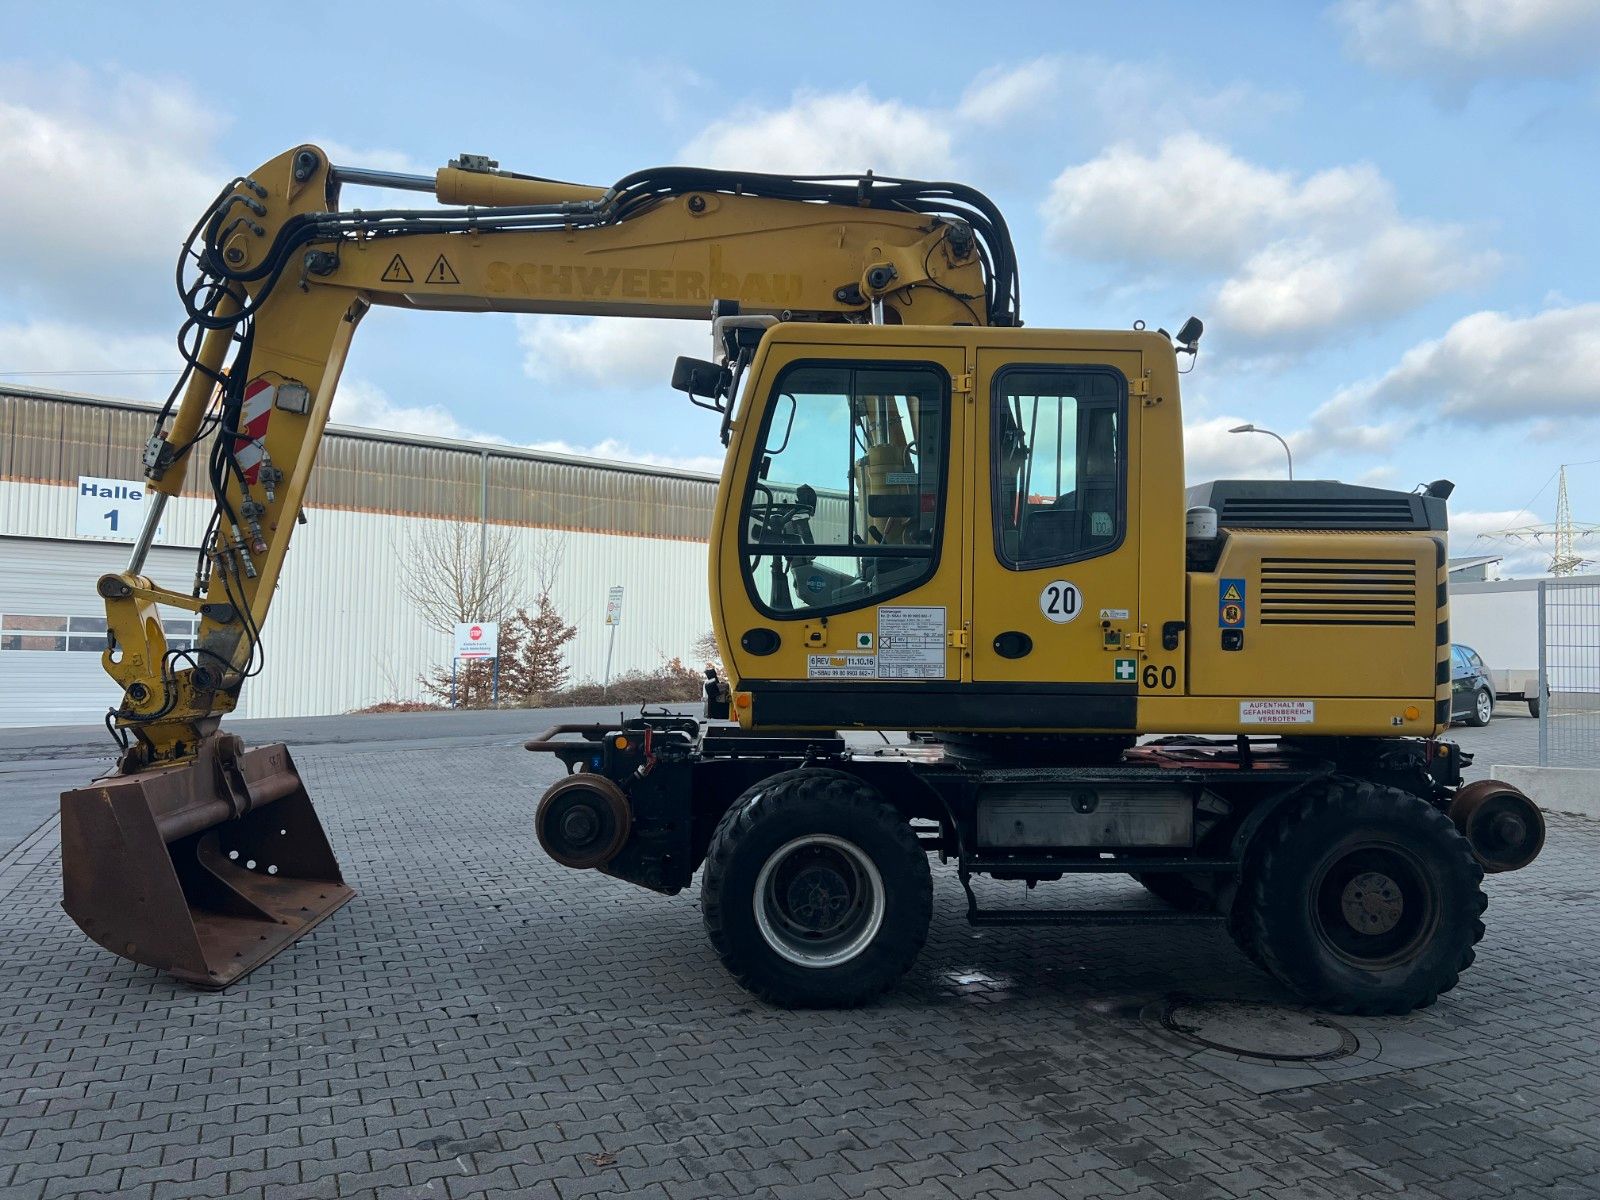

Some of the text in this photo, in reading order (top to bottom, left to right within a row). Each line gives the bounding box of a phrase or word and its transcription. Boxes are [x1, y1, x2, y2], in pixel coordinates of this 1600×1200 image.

[81, 483, 143, 500] Halle
[104, 509, 119, 531] 1
[1047, 586, 1076, 614] 20
[848, 658, 874, 666] 11.10.16
[1142, 665, 1177, 690] 60
